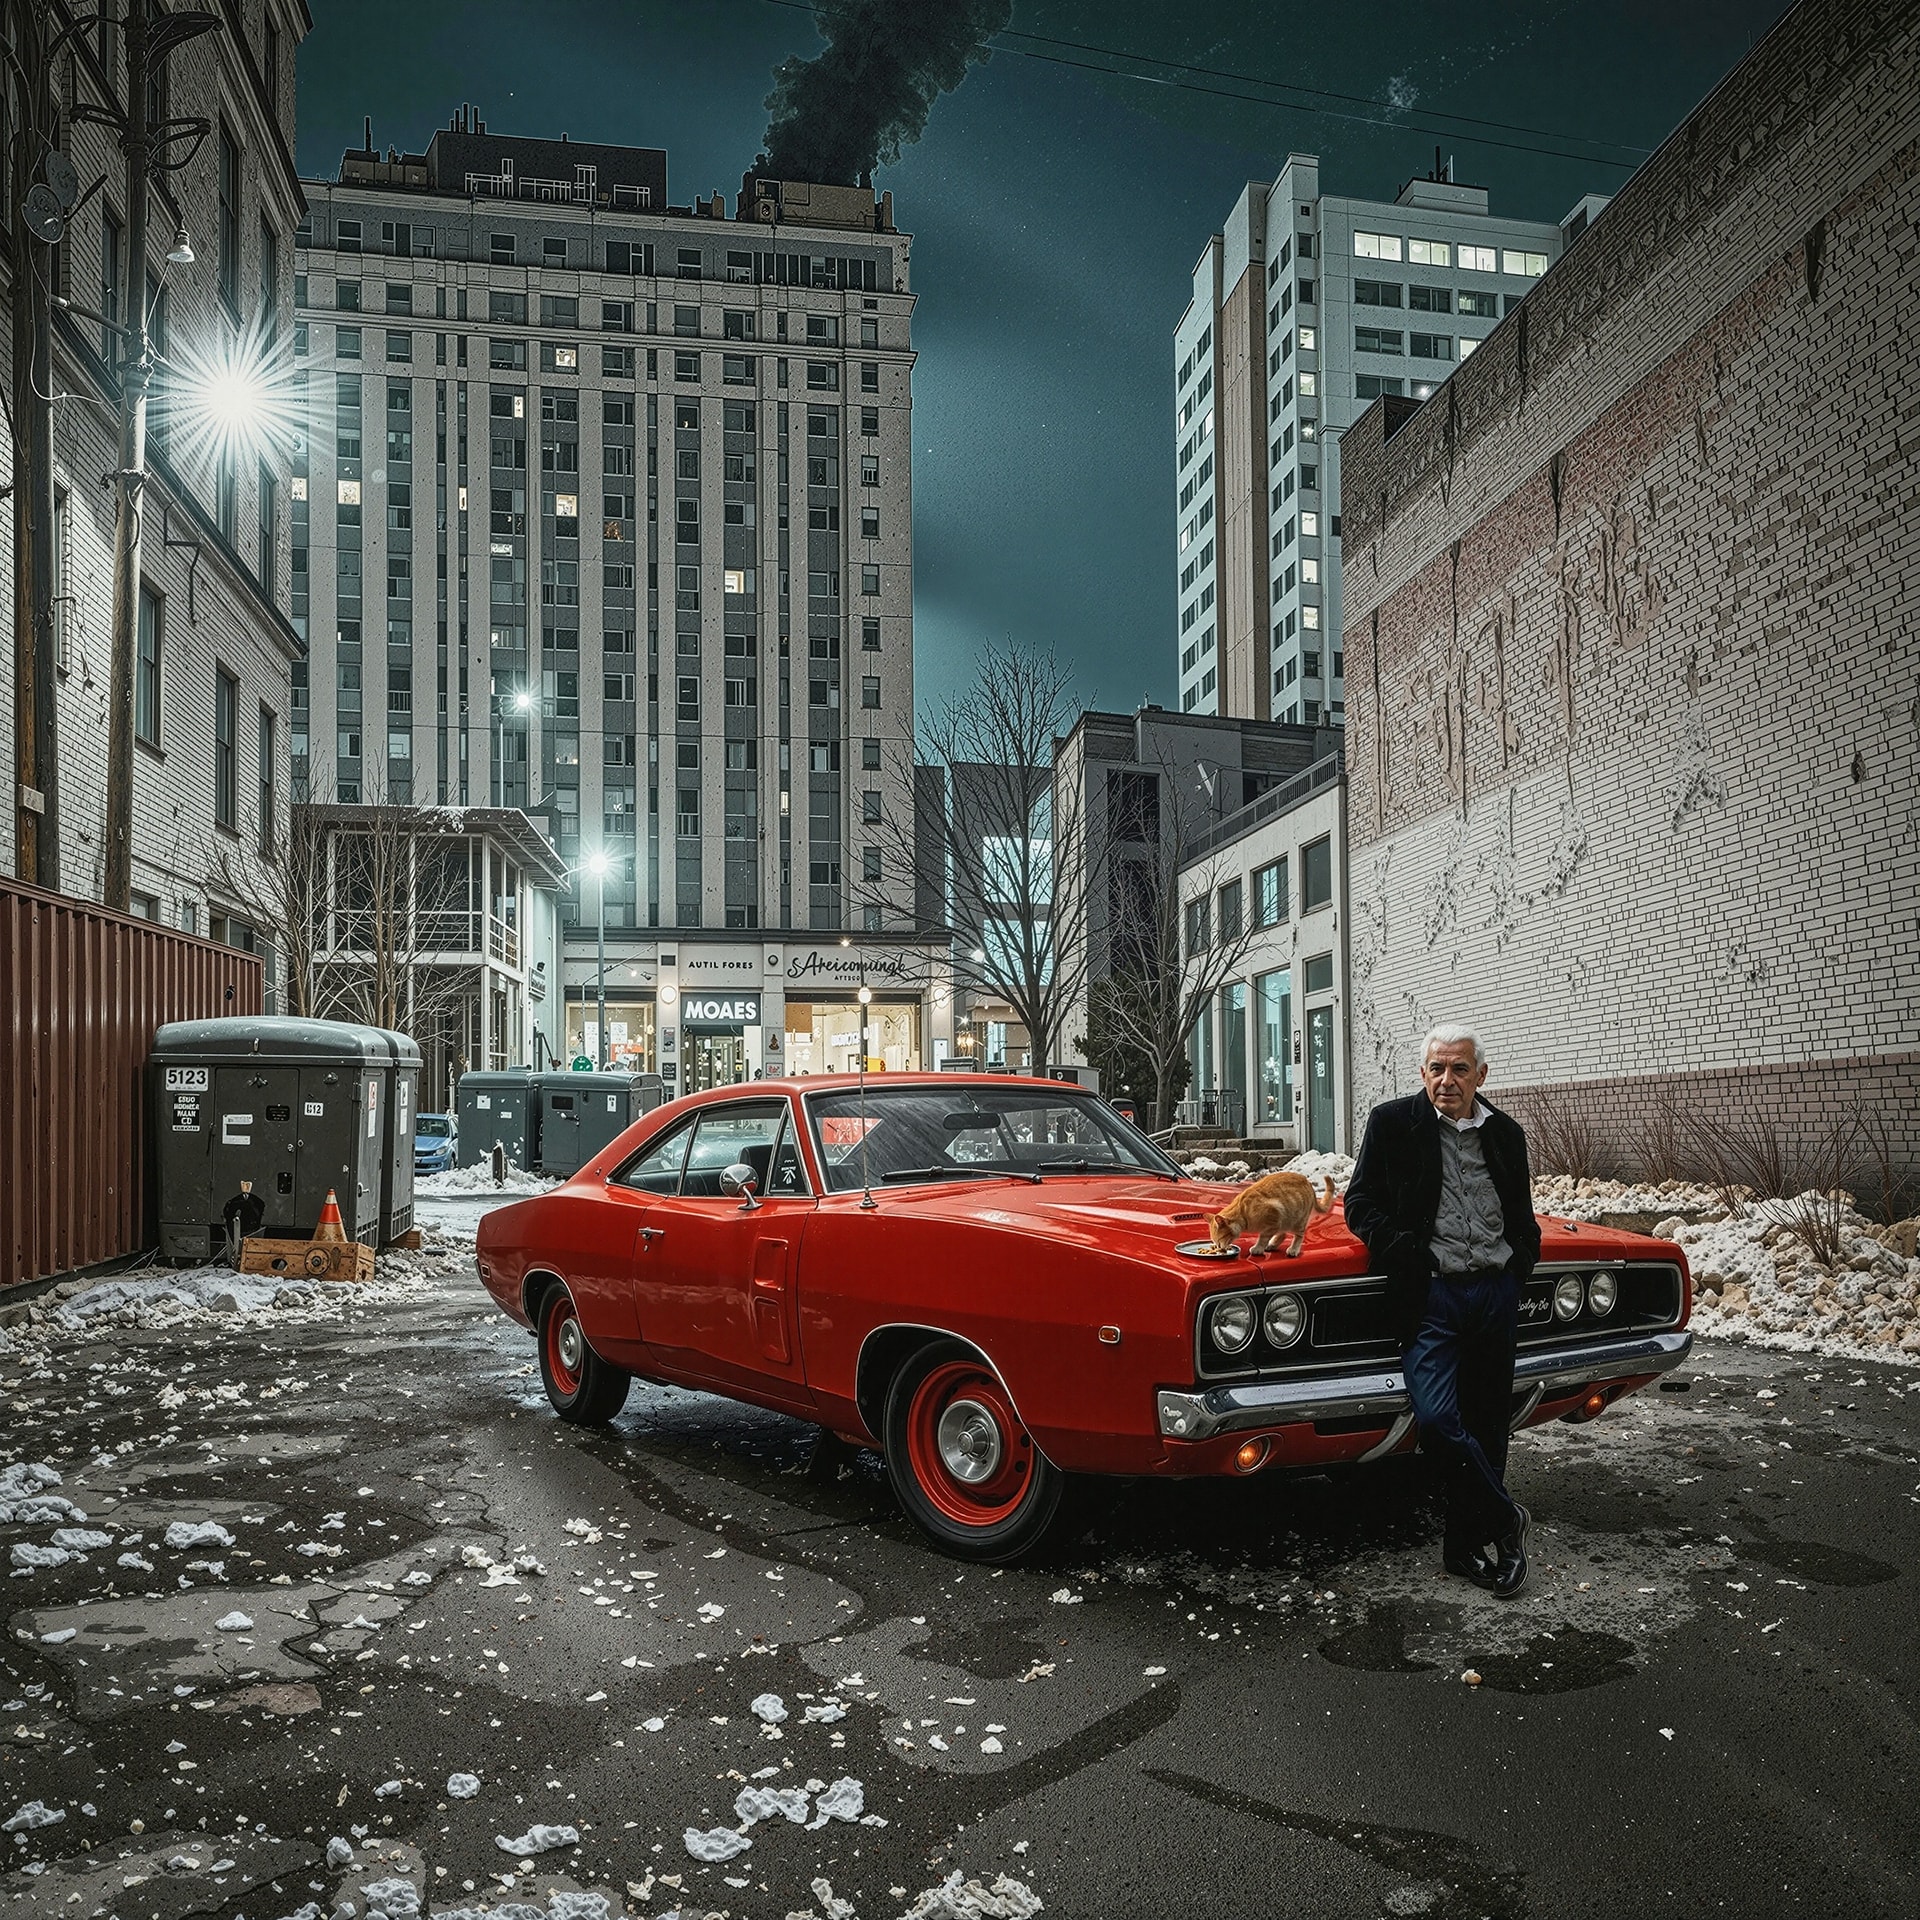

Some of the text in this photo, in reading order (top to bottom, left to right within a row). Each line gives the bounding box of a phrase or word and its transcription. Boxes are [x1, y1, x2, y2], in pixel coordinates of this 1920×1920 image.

[688, 961, 753, 969] AUTIL FORES
[684, 1001, 757, 1020] MOAES
[167, 1070, 206, 1085] 5123
